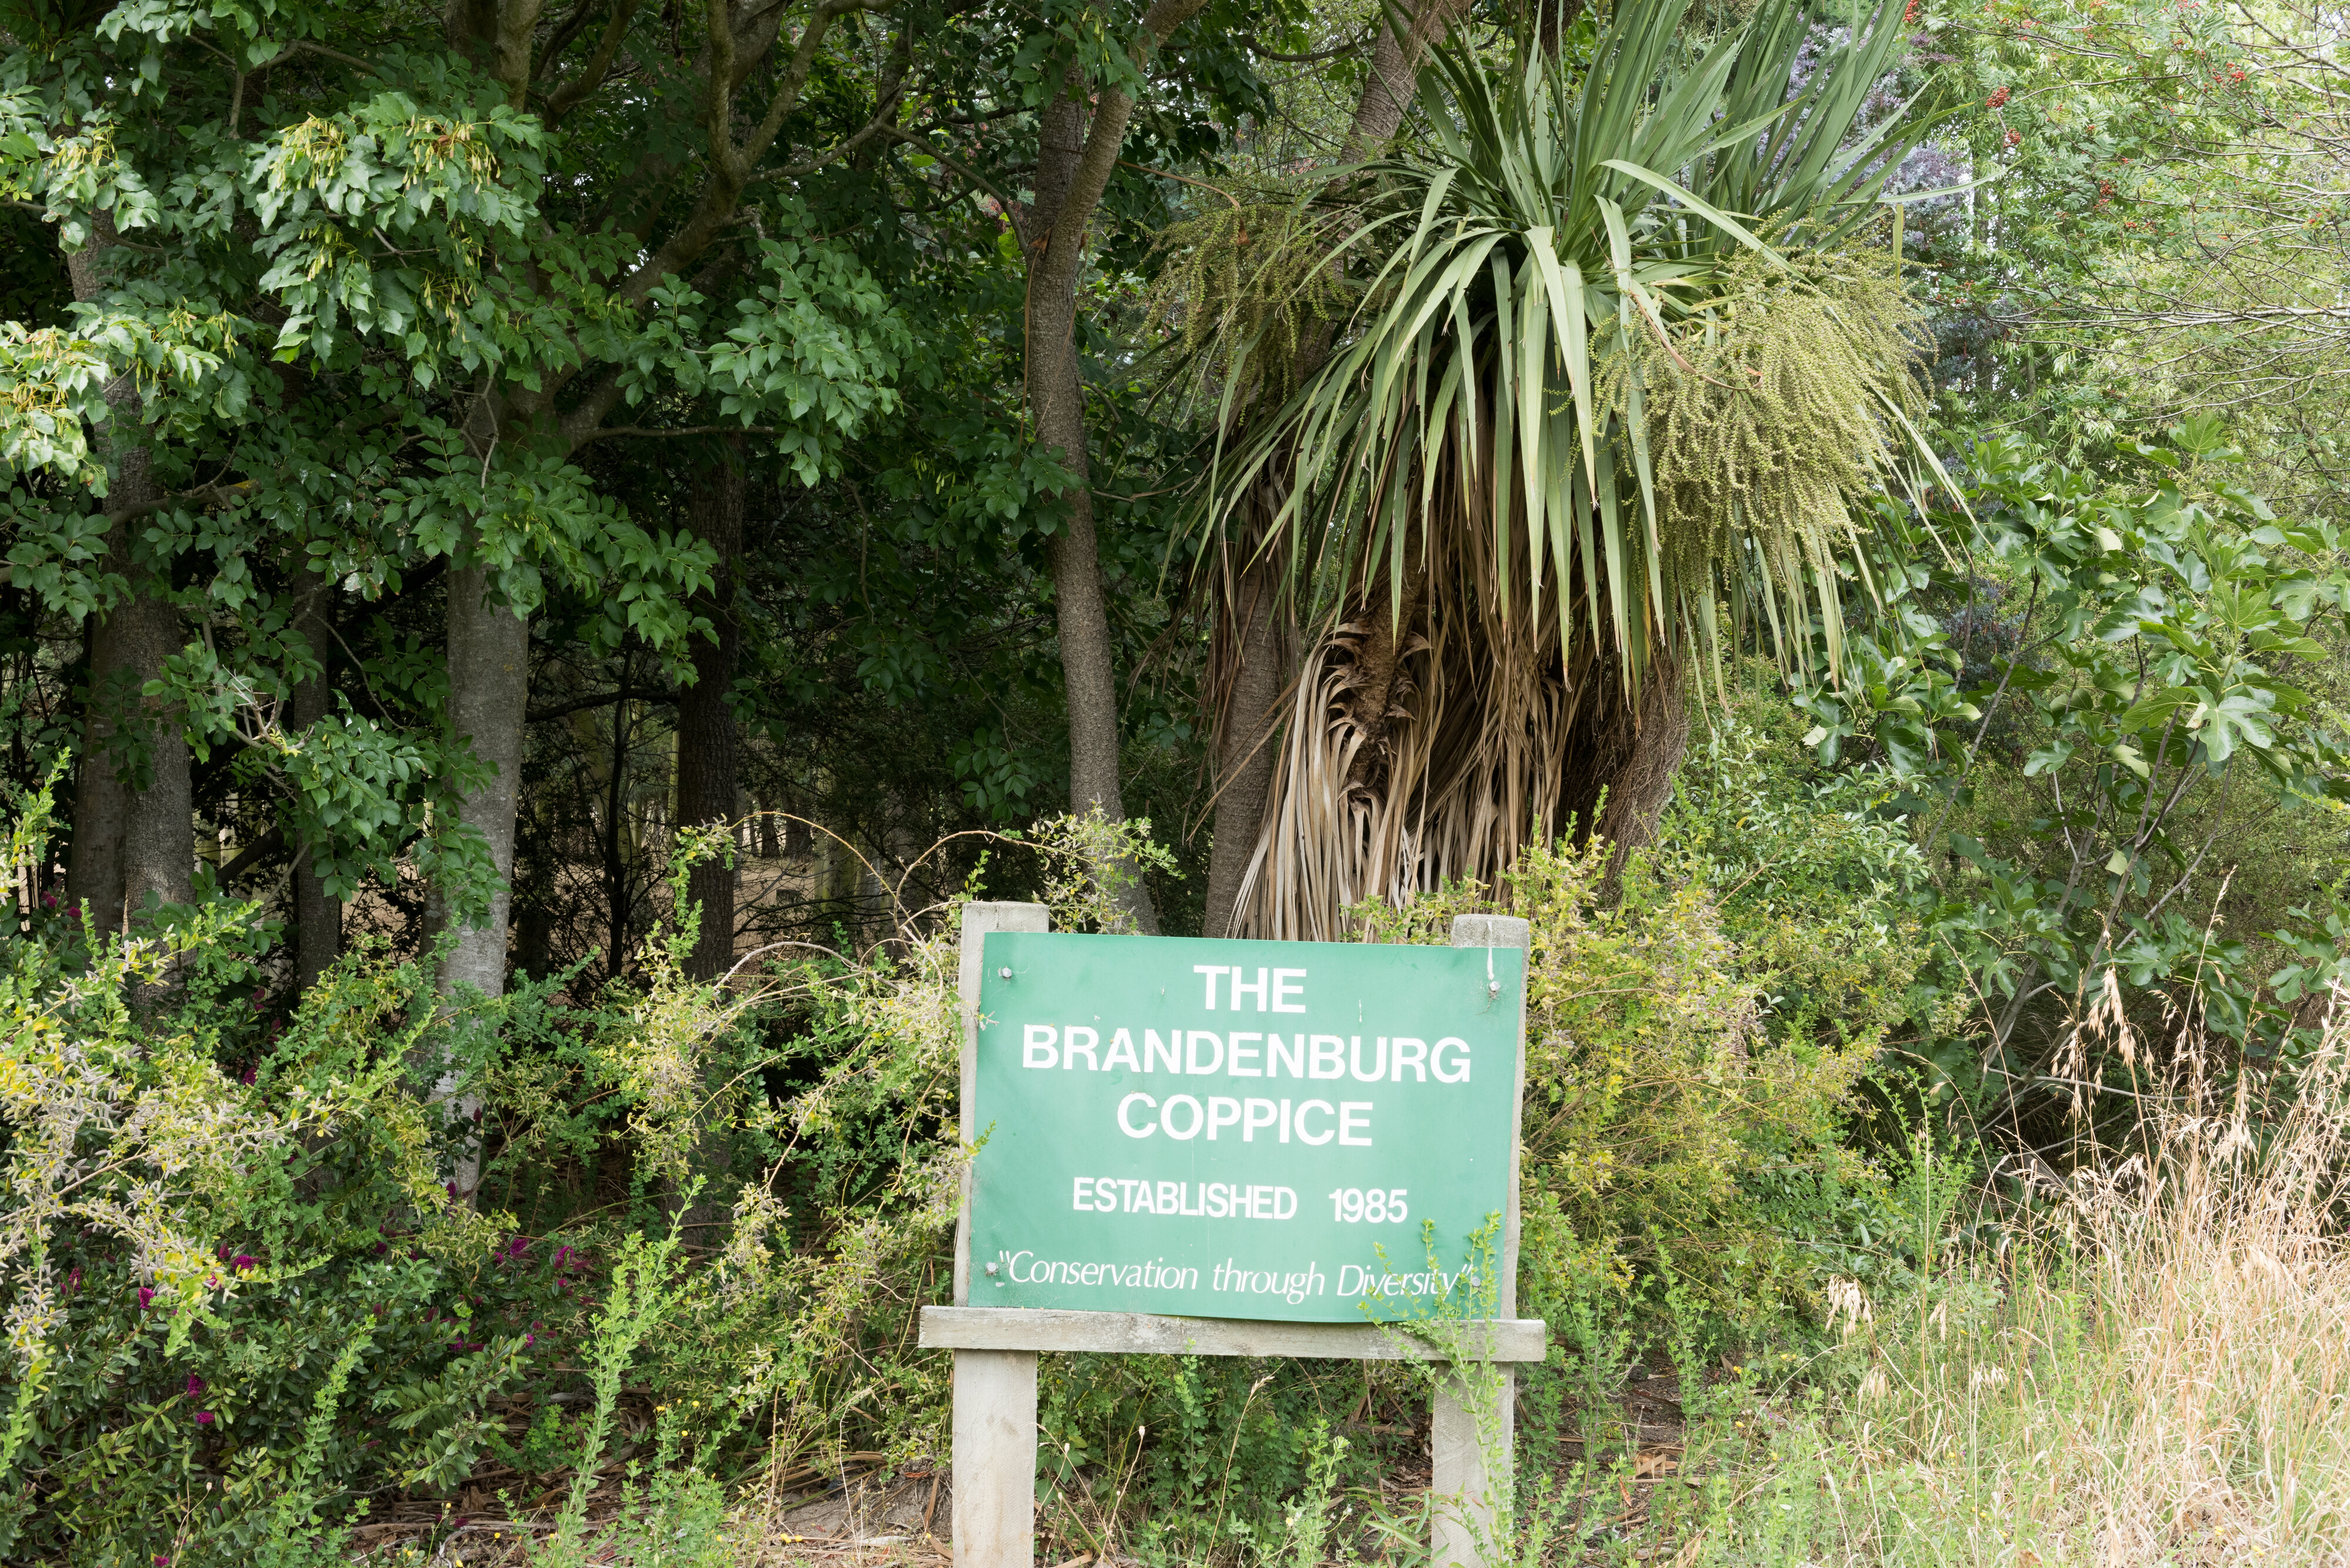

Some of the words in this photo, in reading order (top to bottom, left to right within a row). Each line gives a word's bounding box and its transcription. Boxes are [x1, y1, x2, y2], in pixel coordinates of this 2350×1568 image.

[1193, 965, 1307, 1013] THE
[1023, 1023, 1471, 1083] BRANDENBURG
[1117, 1092, 1373, 1147] COPPICE
[1073, 1176, 1298, 1220] ESTABLISHED
[1328, 1187, 1408, 1224] 1985
[1212, 1257, 1325, 1305] through
